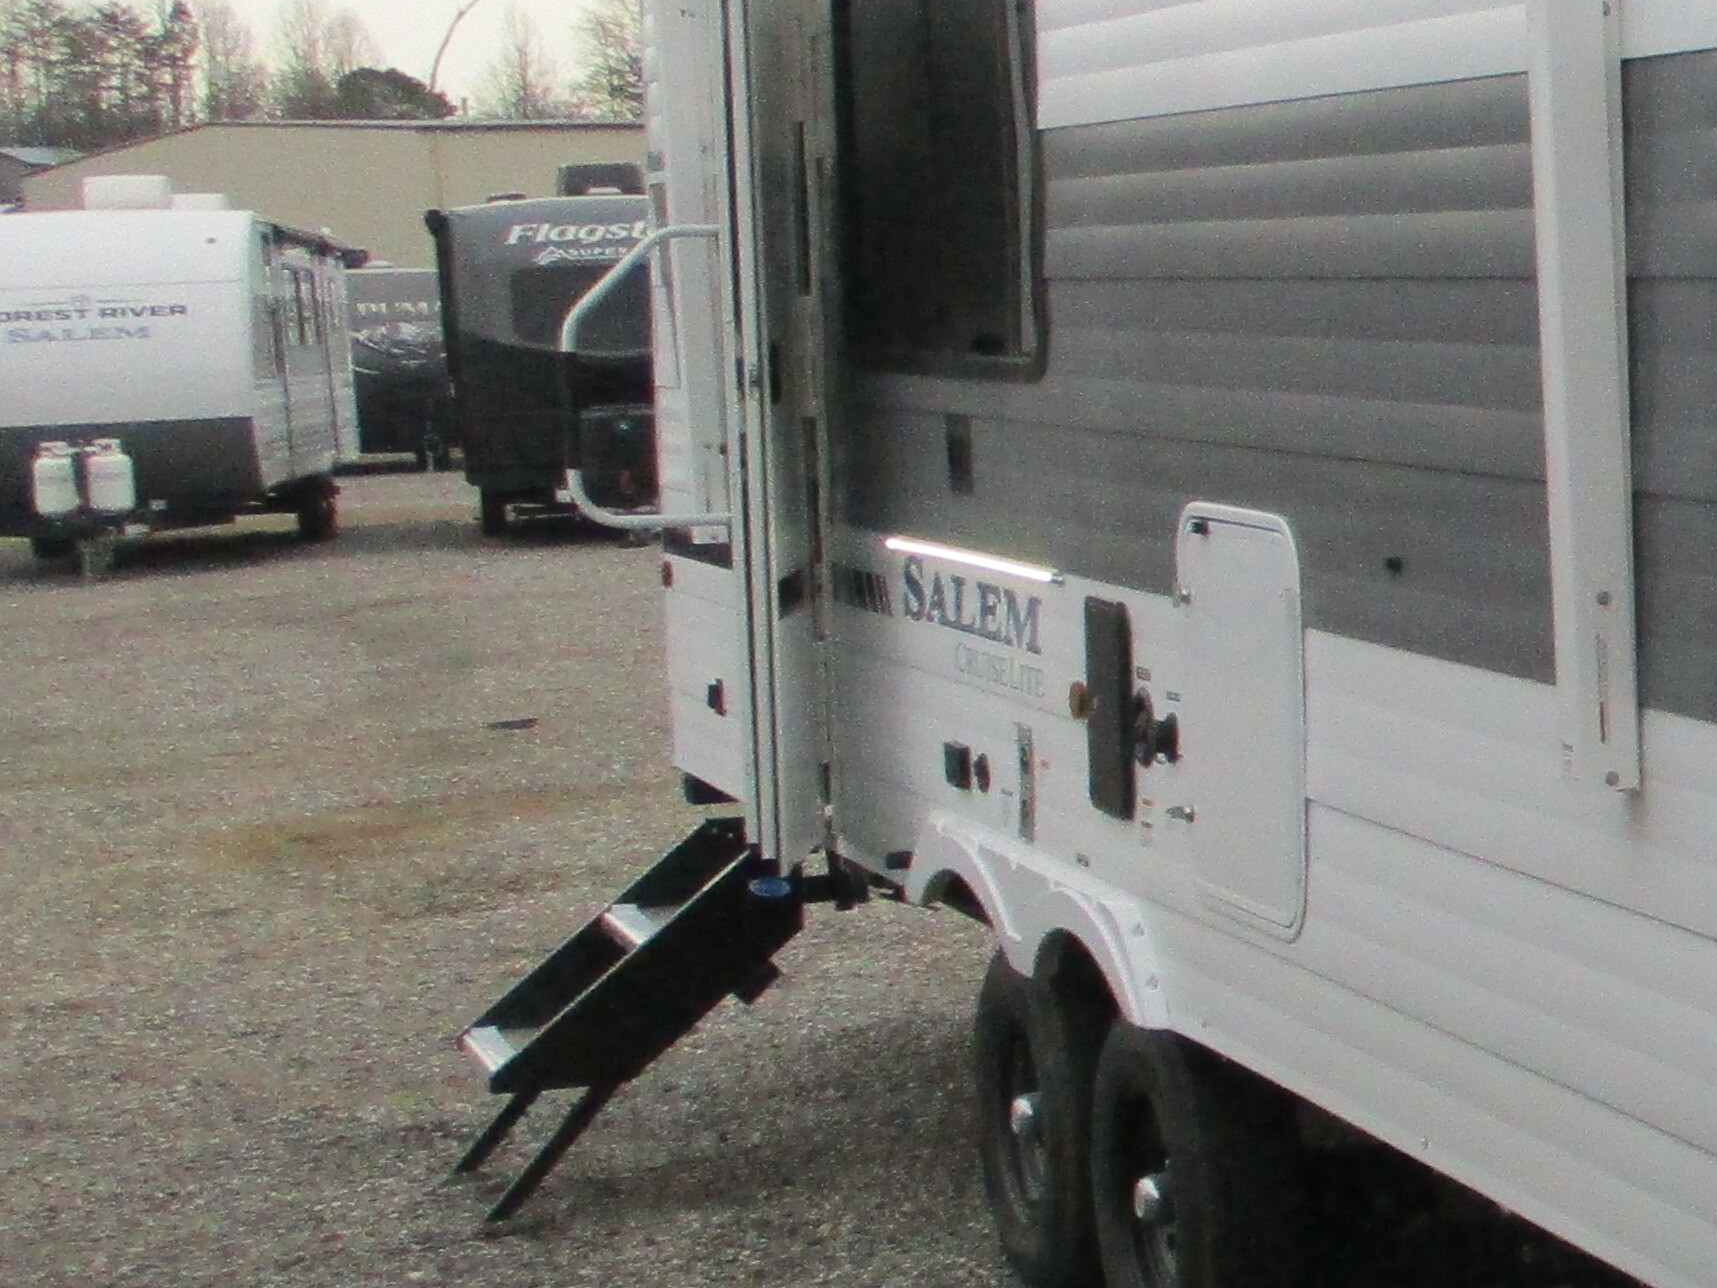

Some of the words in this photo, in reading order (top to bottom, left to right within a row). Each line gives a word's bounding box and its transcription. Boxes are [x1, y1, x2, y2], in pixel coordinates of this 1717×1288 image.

[98, 304, 189, 318] RIVER
[7, 326, 152, 344] SALEM
[903, 554, 1044, 656] SALEM
